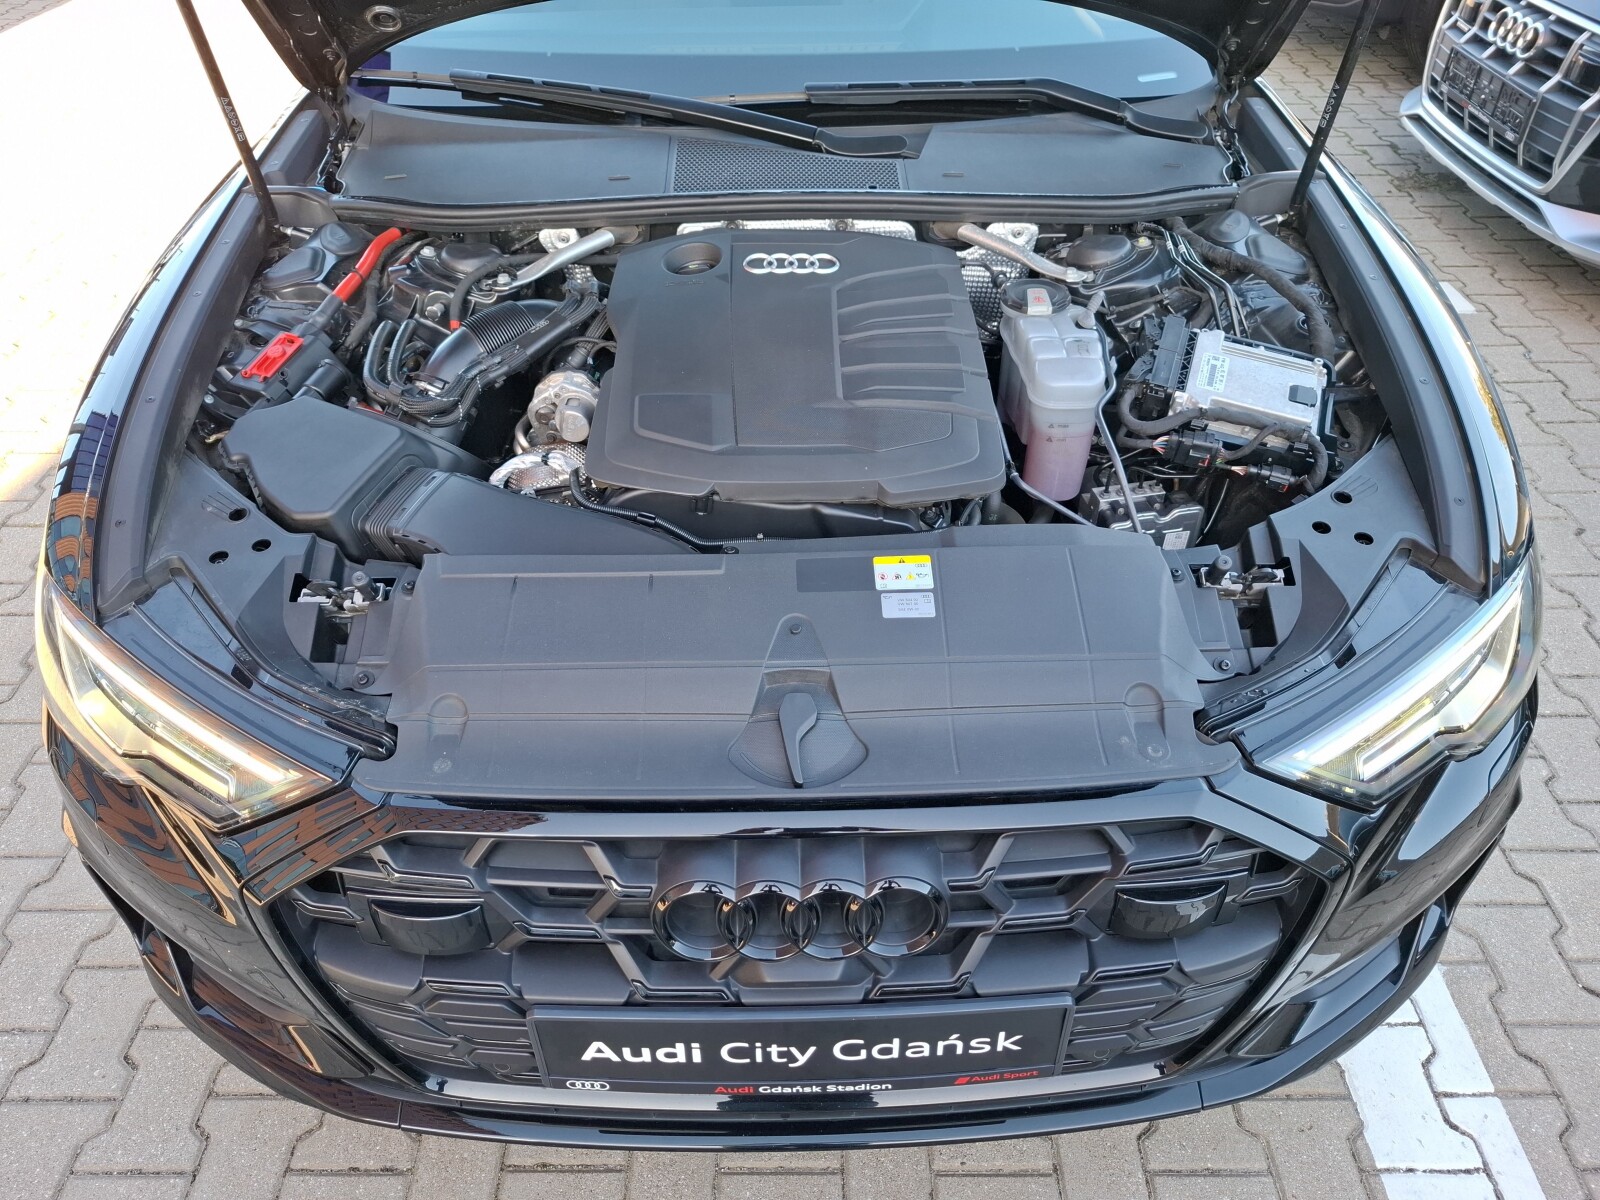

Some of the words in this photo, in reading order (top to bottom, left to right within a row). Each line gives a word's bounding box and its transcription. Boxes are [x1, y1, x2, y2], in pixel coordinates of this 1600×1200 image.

[580, 1041, 703, 1064] Audi
[719, 1041, 818, 1068] City
[832, 1031, 1024, 1061] Gdańsk
[971, 1073, 1000, 1083] Audi
[1003, 1070, 1039, 1081] Sport
[714, 1086, 754, 1094] Audi
[758, 1085, 822, 1094] Gdańsk
[825, 1082, 892, 1093] Stadion
